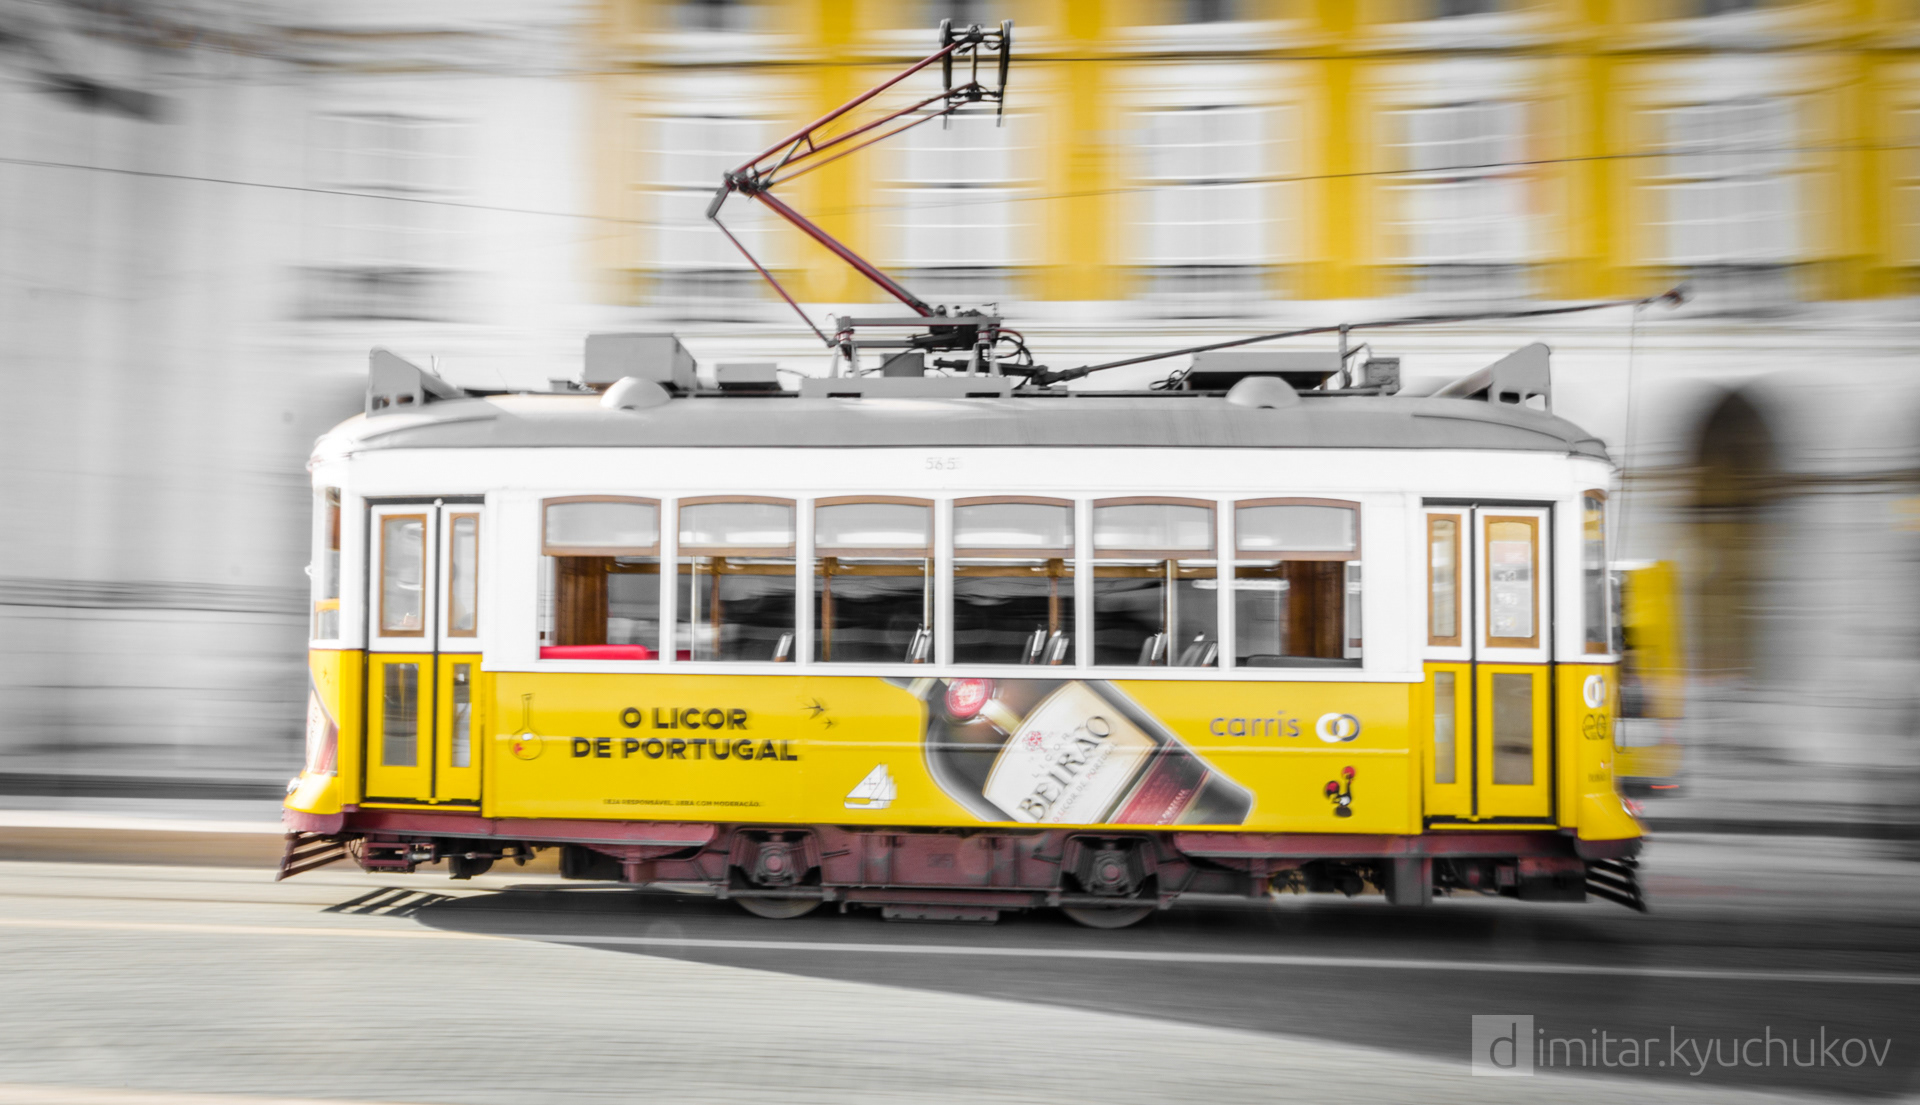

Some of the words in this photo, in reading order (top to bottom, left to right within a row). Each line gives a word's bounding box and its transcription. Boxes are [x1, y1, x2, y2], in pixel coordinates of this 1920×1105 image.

[924, 456, 959, 471] 565
[619, 706, 643, 729] O
[652, 707, 750, 730] LICOR
[1209, 710, 1301, 737] carris
[570, 736, 612, 758] DE
[621, 737, 799, 761] PORTUGAL
[1017, 715, 1111, 823] BEIRÃO
